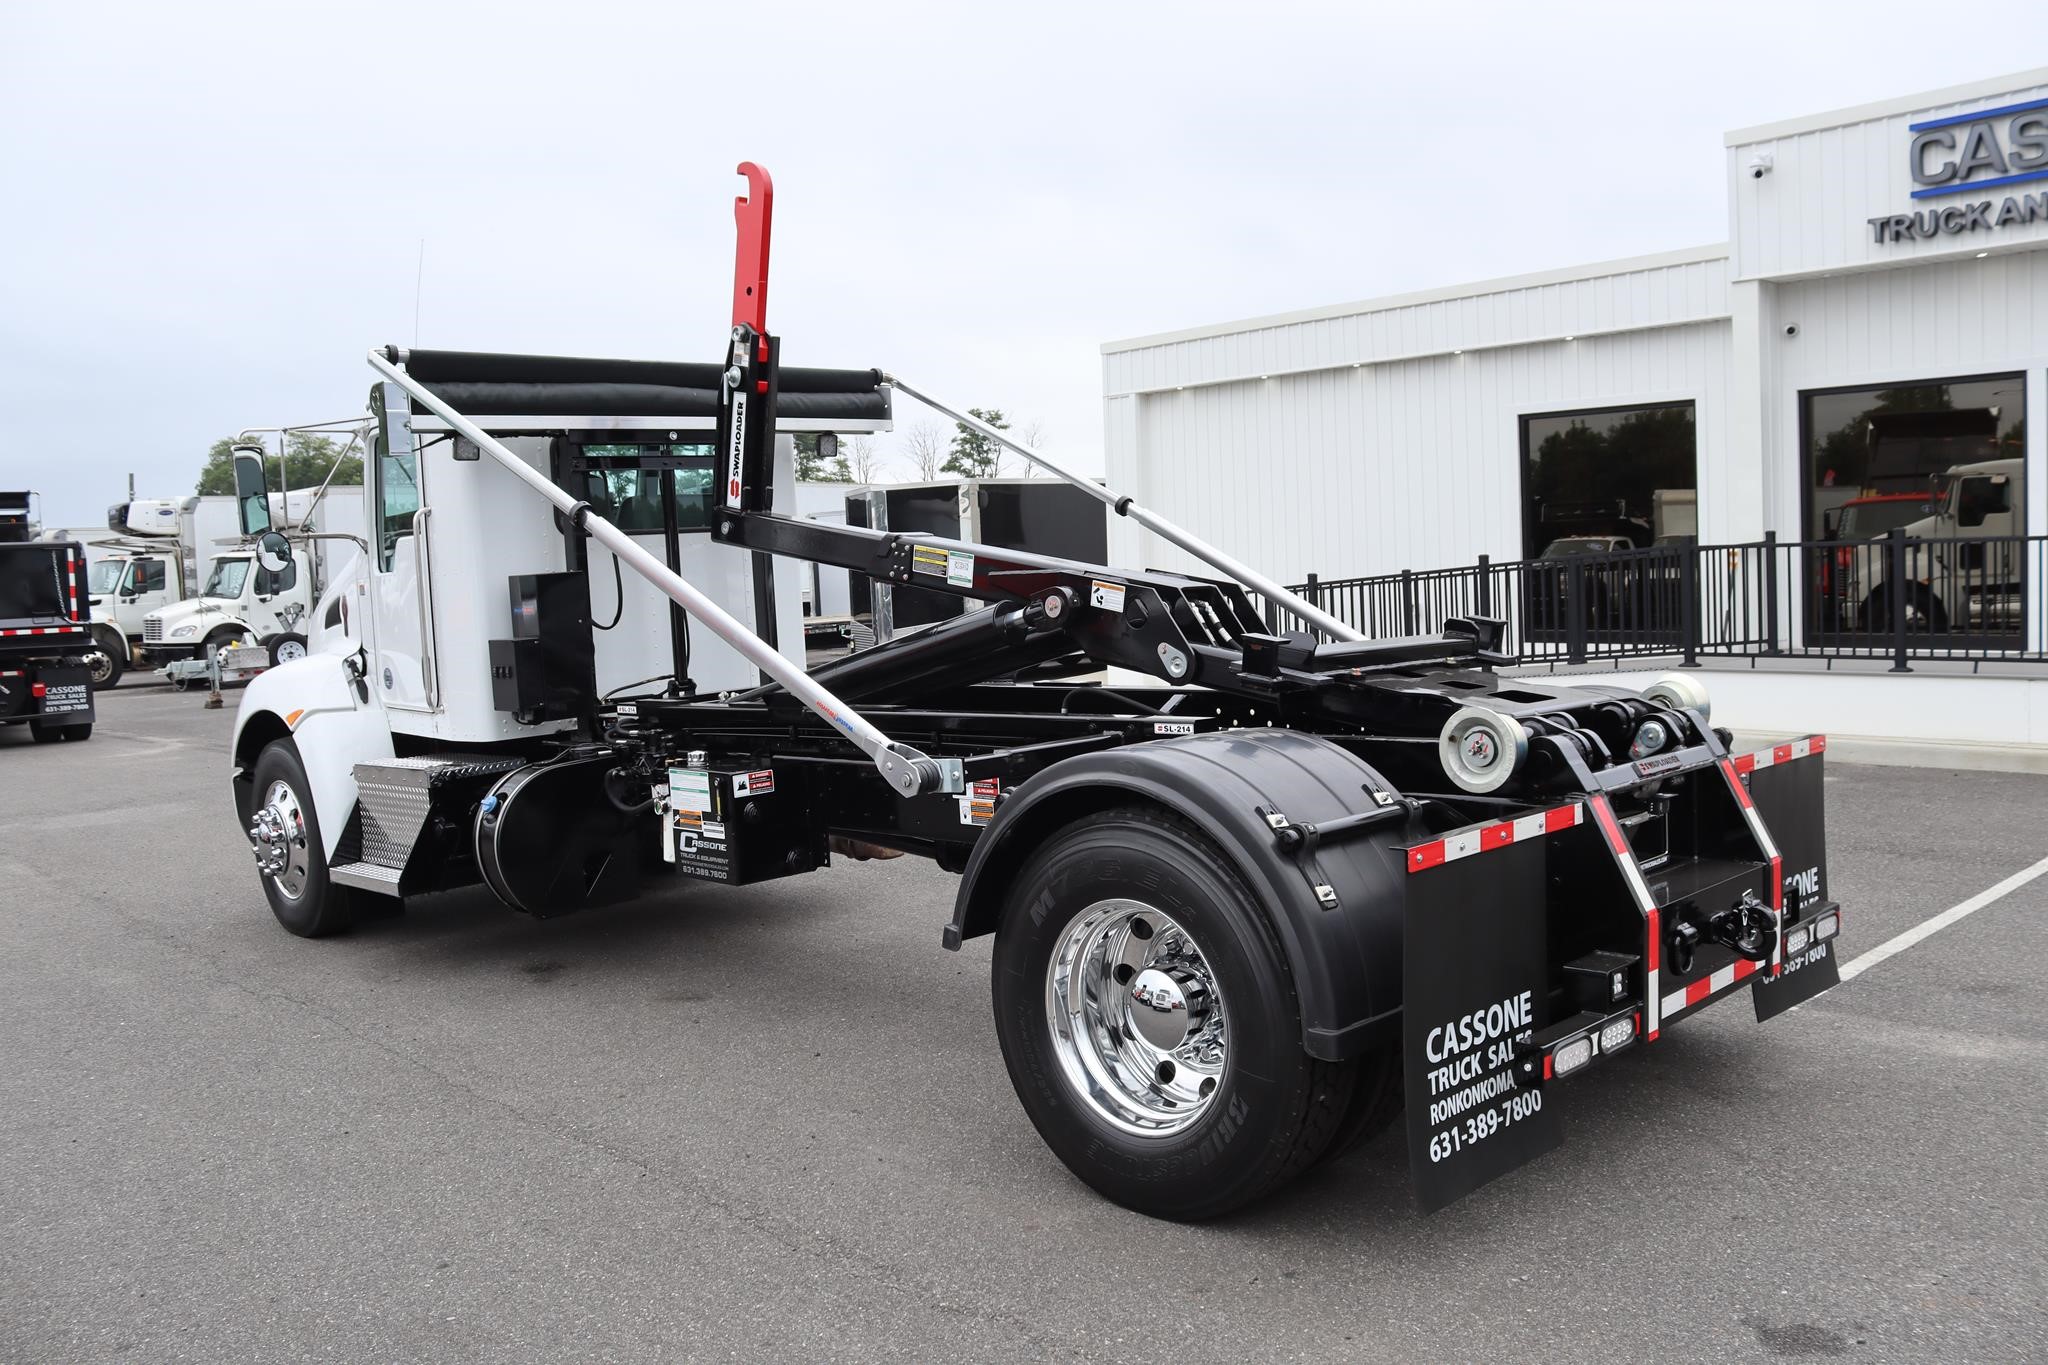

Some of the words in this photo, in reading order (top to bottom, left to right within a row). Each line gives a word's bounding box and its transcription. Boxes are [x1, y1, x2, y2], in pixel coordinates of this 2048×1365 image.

[1910, 111, 2048, 186] CAS
[1867, 200, 1992, 244] TRUCK
[732, 401, 744, 477] SWAPLOADER
[45, 685, 87, 694] CASSONE
[1163, 725, 1191, 733] SL-214
[1426, 990, 1533, 1064] CASSONE
[1427, 1051, 1483, 1096] TRUCK
[1429, 1089, 1542, 1163] 631-389-7800
